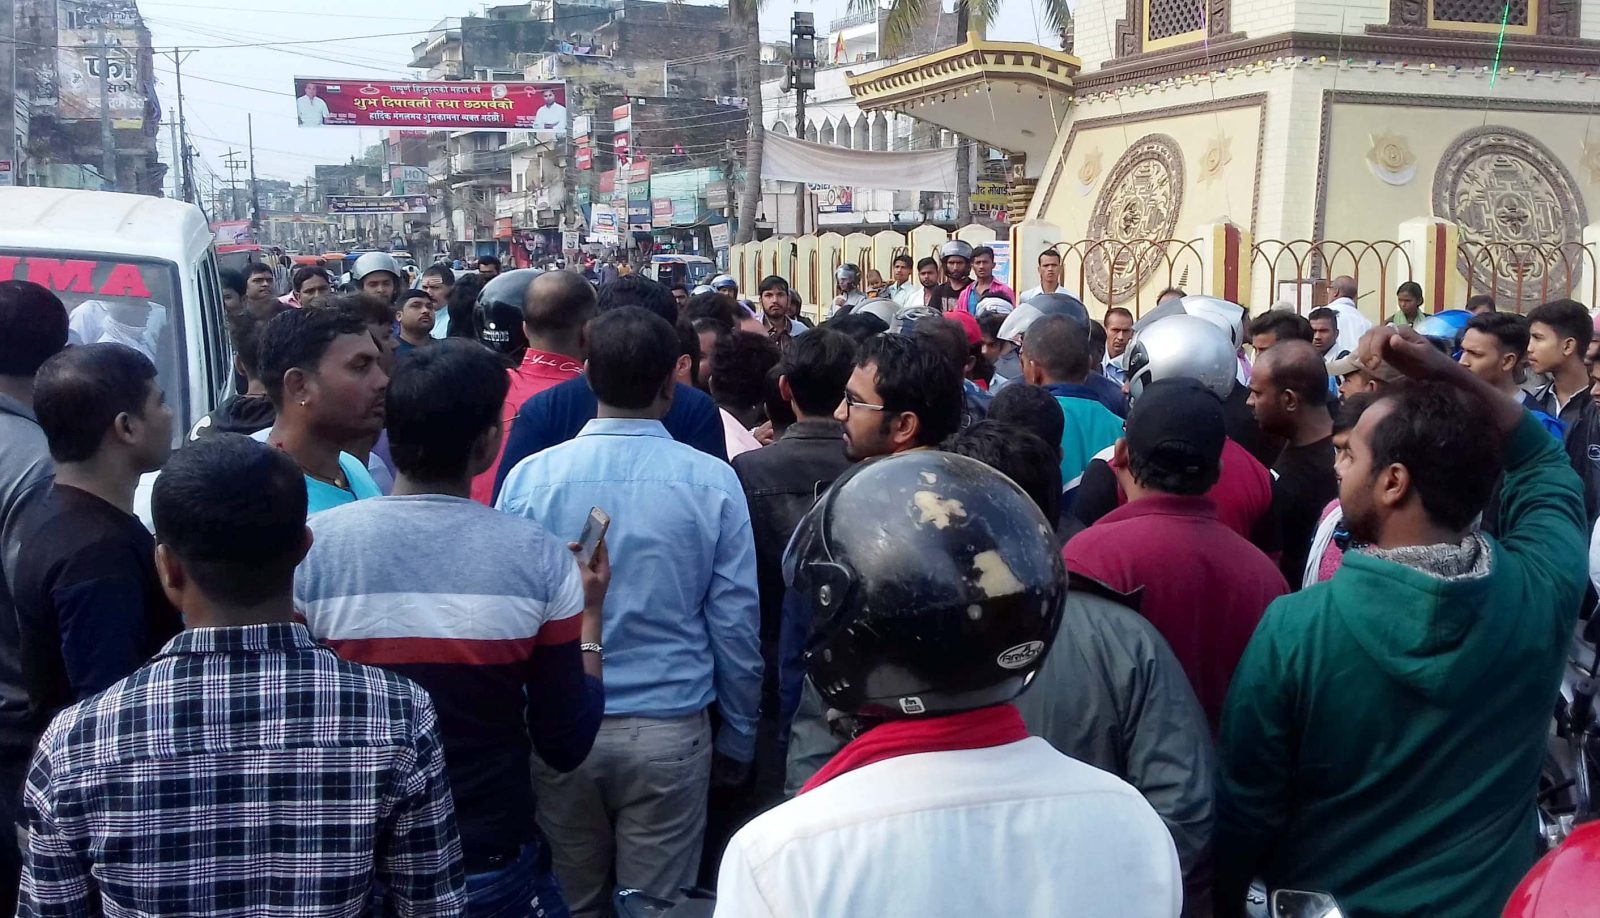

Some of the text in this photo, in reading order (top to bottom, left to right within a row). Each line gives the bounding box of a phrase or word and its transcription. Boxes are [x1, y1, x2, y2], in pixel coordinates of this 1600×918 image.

[353, 97, 379, 110] शुभ
[381, 95, 432, 108] दिपावली
[435, 99, 461, 109] तथा
